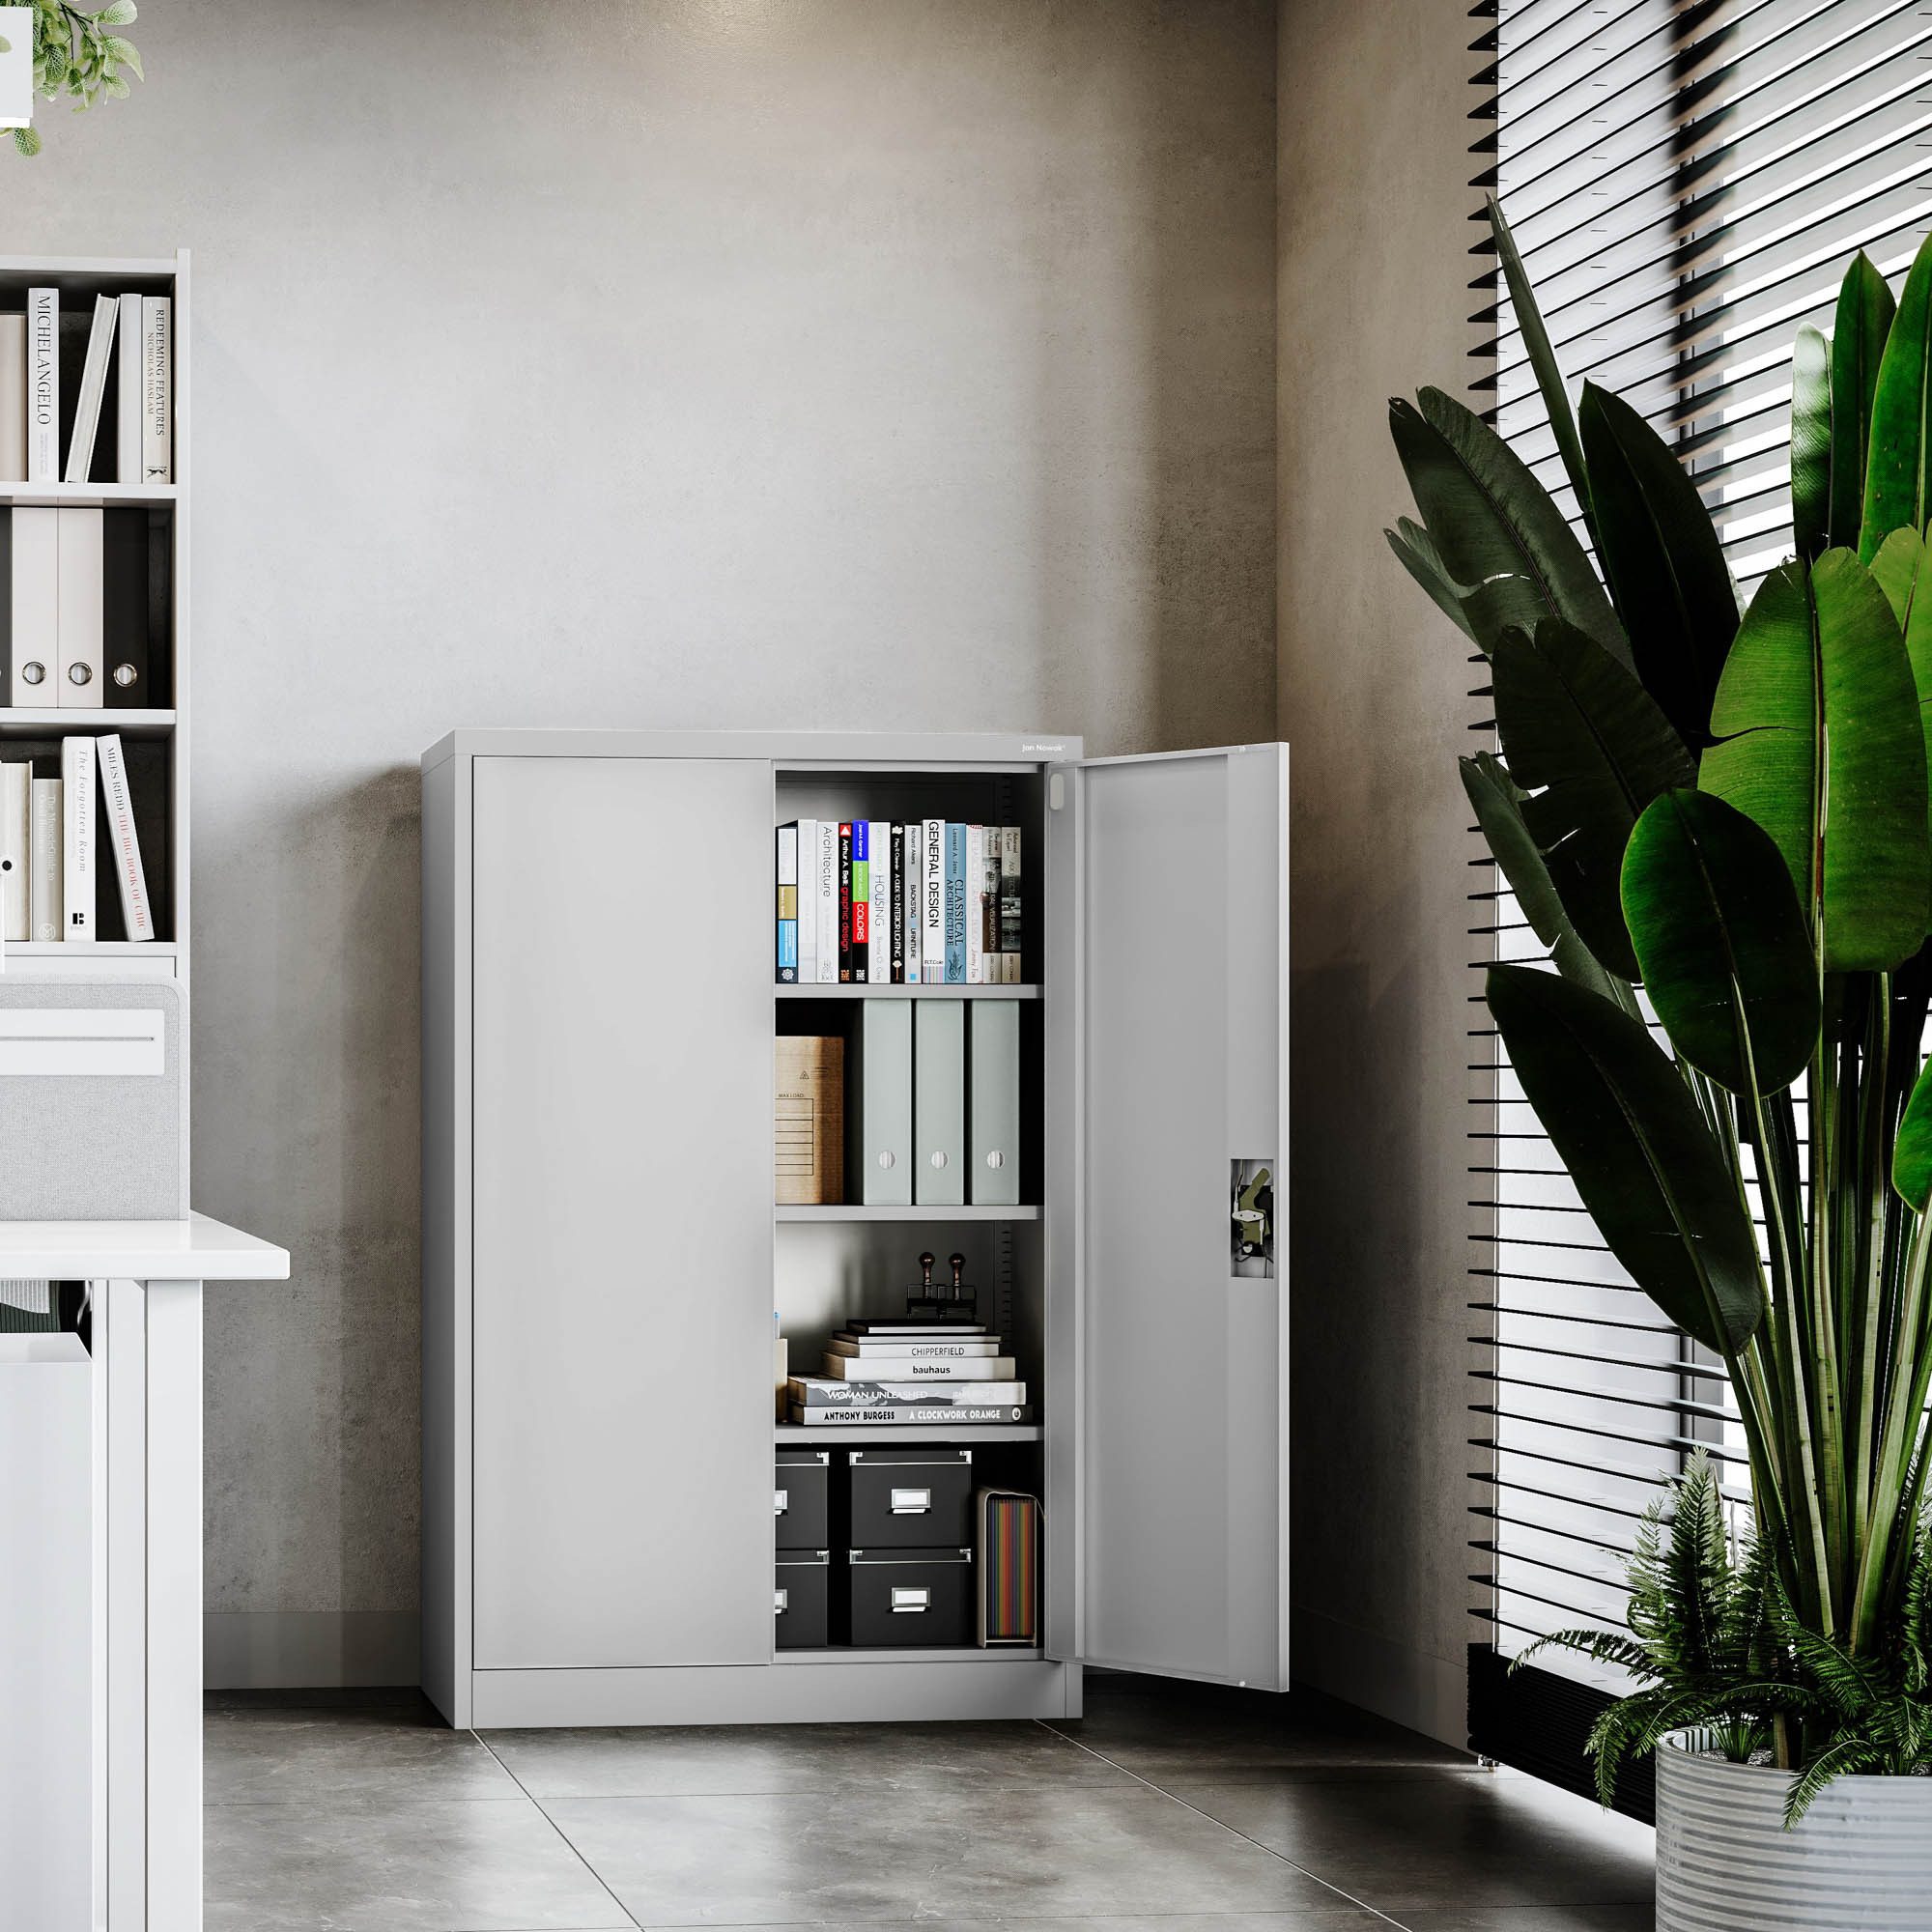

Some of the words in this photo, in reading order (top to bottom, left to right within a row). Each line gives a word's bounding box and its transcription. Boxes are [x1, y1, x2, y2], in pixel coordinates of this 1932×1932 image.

[156, 309, 165, 376] REDEEMING
[37, 295, 51, 426] MICHELANGELO
[156, 380, 165, 437] FEATURES
[78, 750, 88, 770] The
[107, 748, 118, 779] MILES
[1021, 744, 1035, 753] Jan
[78, 775, 88, 835] Forgotten
[112, 781, 125, 810] REDD
[78, 840, 88, 873] Room
[123, 838, 132, 855] BIG
[823, 826, 833, 897] Architecture
[928, 821, 940, 878] GENERAL
[127, 858, 138, 886] BOOK
[840, 887, 850, 921] graphic
[875, 874, 885, 926] HOUSING
[928, 881, 940, 927] DESIGN
[954, 879, 964, 946] CLASSICAL
[840, 922, 850, 952] design
[856, 903, 865, 941] COLORS
[911, 1347, 965, 1356] CHIPPERFIELD
[912, 1365, 951, 1375] bauhaus
[827, 1391, 868, 1400] WOMAN
[871, 1391, 927, 1400] UNLEASHED
[824, 1411, 861, 1420] ANTHONY
[863, 1410, 895, 1420] BURGESS
[909, 1410, 915, 1420] A
[917, 1409, 967, 1420] CLOCKWORK
[969, 1409, 1001, 1419] ORANGE
